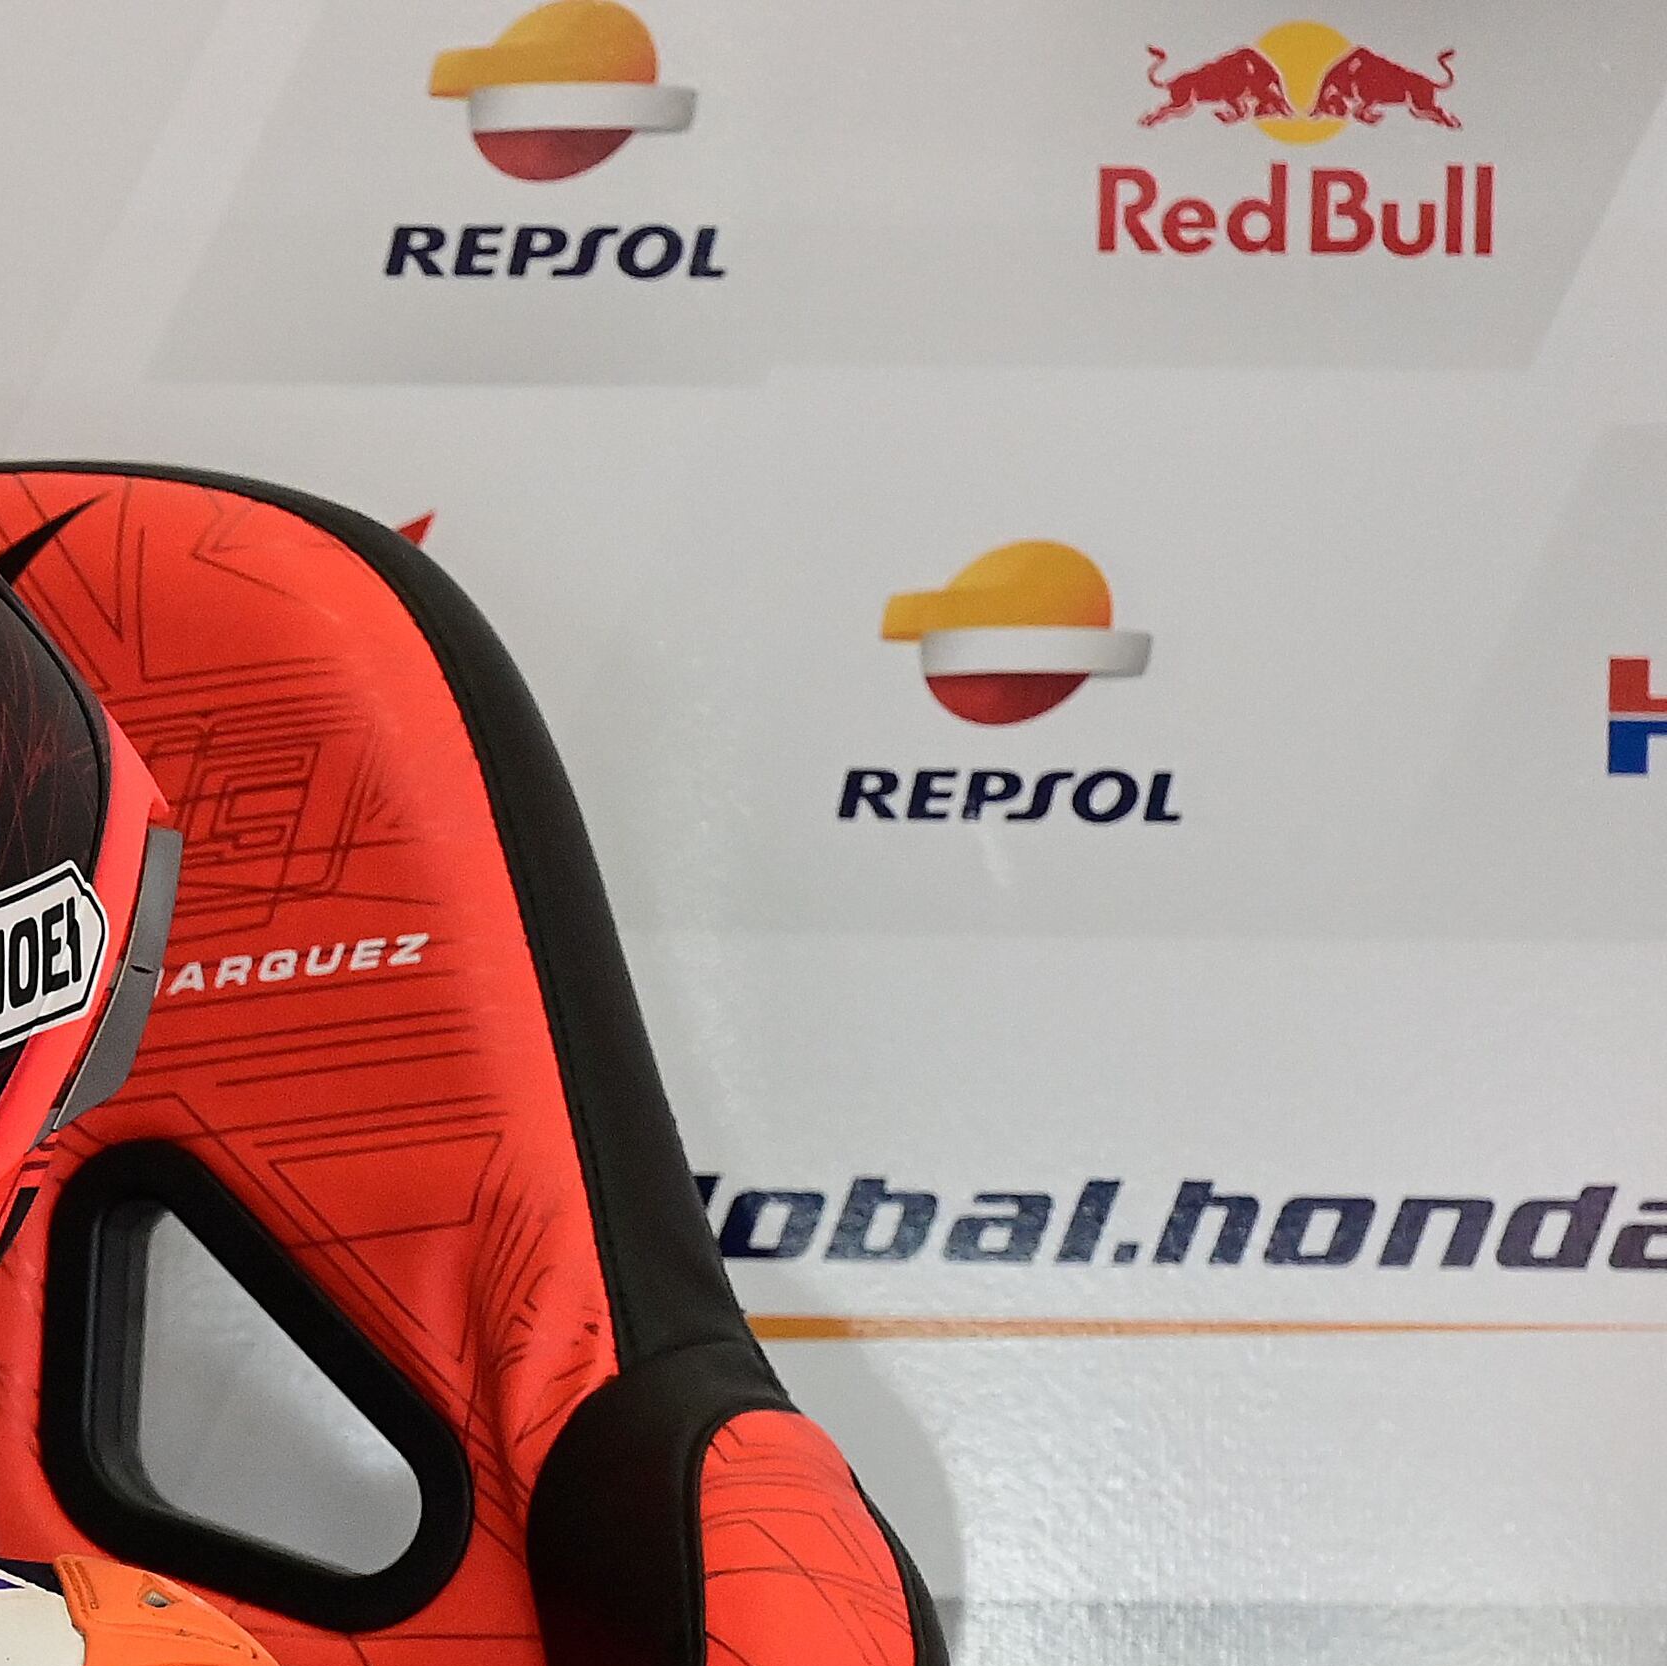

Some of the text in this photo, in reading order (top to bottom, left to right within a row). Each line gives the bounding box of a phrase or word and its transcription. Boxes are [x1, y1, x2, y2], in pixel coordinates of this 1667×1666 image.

[1096, 164, 1496, 257] Red Bull
[384, 224, 727, 280] REPSOL
[836, 768, 1183, 825] REPSOL
[153, 932, 431, 999] ARQUEZ
